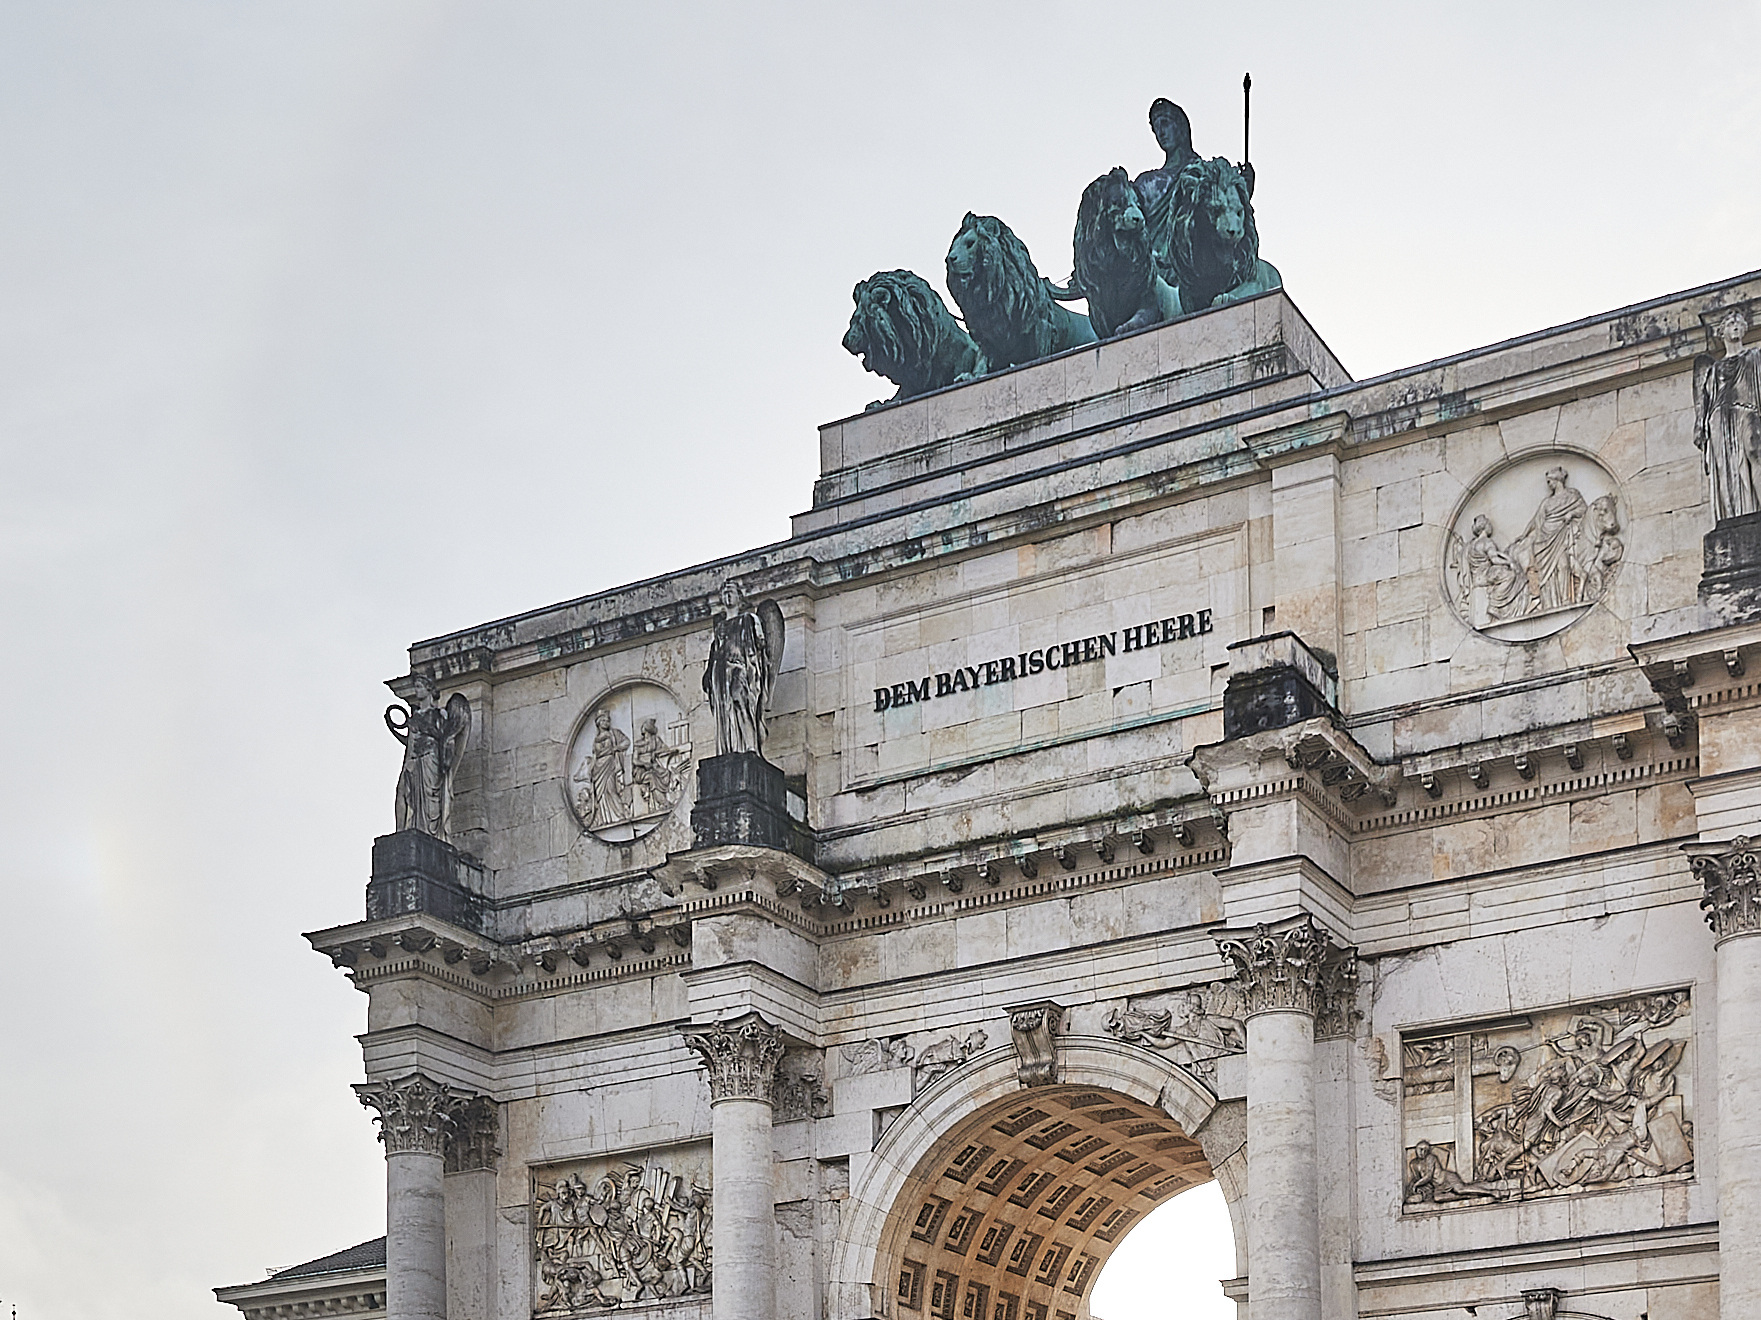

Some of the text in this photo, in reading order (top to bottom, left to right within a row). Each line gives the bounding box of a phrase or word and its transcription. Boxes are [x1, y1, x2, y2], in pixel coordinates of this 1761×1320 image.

[874, 607, 1214, 713] DEM BAYERISCHEN HEERE
